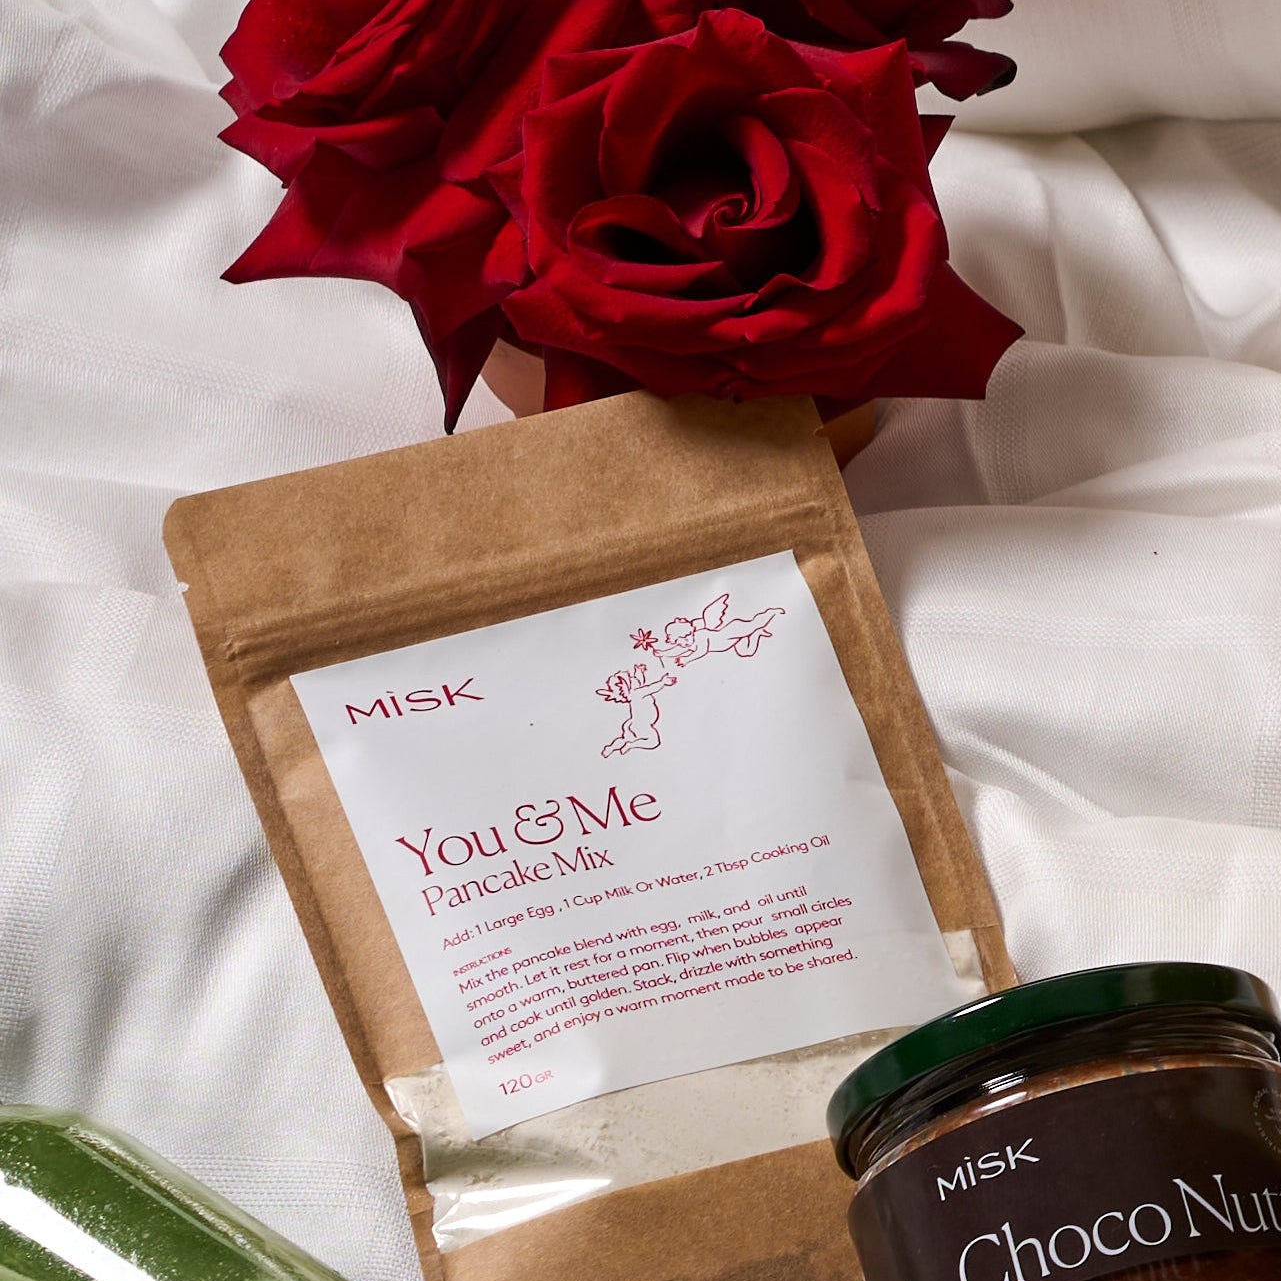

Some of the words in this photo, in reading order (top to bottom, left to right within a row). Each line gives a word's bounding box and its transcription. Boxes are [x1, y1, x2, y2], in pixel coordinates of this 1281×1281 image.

[395, 827, 508, 876] You
[514, 800, 564, 845] &
[565, 786, 661, 836] Me
[421, 859, 553, 916] Pancake
[551, 847, 614, 876] Mix
[444, 929, 474, 950] Add:
[475, 925, 482, 934] 1
[484, 914, 524, 931] Large
[563, 899, 570, 908] 1
[573, 895, 602, 906] Cup
[605, 886, 634, 899] Milk
[636, 882, 653, 892] Or
[655, 872, 702, 887] Water,
[704, 866, 714, 876] 2
[715, 859, 748, 873] Tbsp
[751, 843, 809, 862] Cooking
[810, 835, 830, 847] Oil
[459, 978, 484, 994] Mix
[485, 967, 509, 981] the
[512, 946, 571, 974] pancake
[573, 933, 613, 951] blend
[616, 926, 646, 940] with
[688, 909, 720, 924] milk,
[723, 900, 750, 915] and
[758, 894, 773, 906] oil
[777, 885, 807, 901] until
[453, 947, 512, 977] INSTRUCTIONS
[467, 982, 523, 1012] smooth.
[524, 971, 548, 985] Let
[549, 967, 561, 976] it
[564, 958, 590, 972] rest
[593, 953, 612, 964] for
[617, 950, 626, 958] a
[629, 934, 694, 955] moment,
[696, 926, 729, 939] then
[732, 916, 762, 933] pour
[771, 903, 808, 921] small
[811, 897, 852, 912] circles
[474, 1009, 505, 1029] onto
[508, 1004, 517, 1012] a
[519, 986, 565, 1007] warm,
[567, 965, 629, 989] buttered
[632, 961, 664, 976] pan.
[665, 952, 690, 965] Flip
[692, 943, 731, 957] when
[733, 929, 788, 948] bubbles
[795, 917, 842, 935] appear
[481, 1025, 507, 1046] and
[510, 1011, 543, 1032] cook
[546, 996, 576, 1016] until
[580, 987, 631, 1007] golden.
[635, 973, 677, 993] Stack,
[679, 961, 723, 980] drizzle
[725, 953, 756, 968] with
[759, 938, 833, 960] something
[488, 1039, 531, 1064] sweet,
[534, 1022, 560, 1042] and
[564, 1011, 600, 1028] enjoy
[616, 998, 658, 1013] warm
[661, 981, 721, 1003] moment
[725, 970, 765, 987] made
[767, 968, 783, 977] to
[785, 963, 804, 973] be
[807, 949, 858, 968] shared.
[499, 1074, 532, 1095] 120
[535, 1071, 553, 1083] GR
